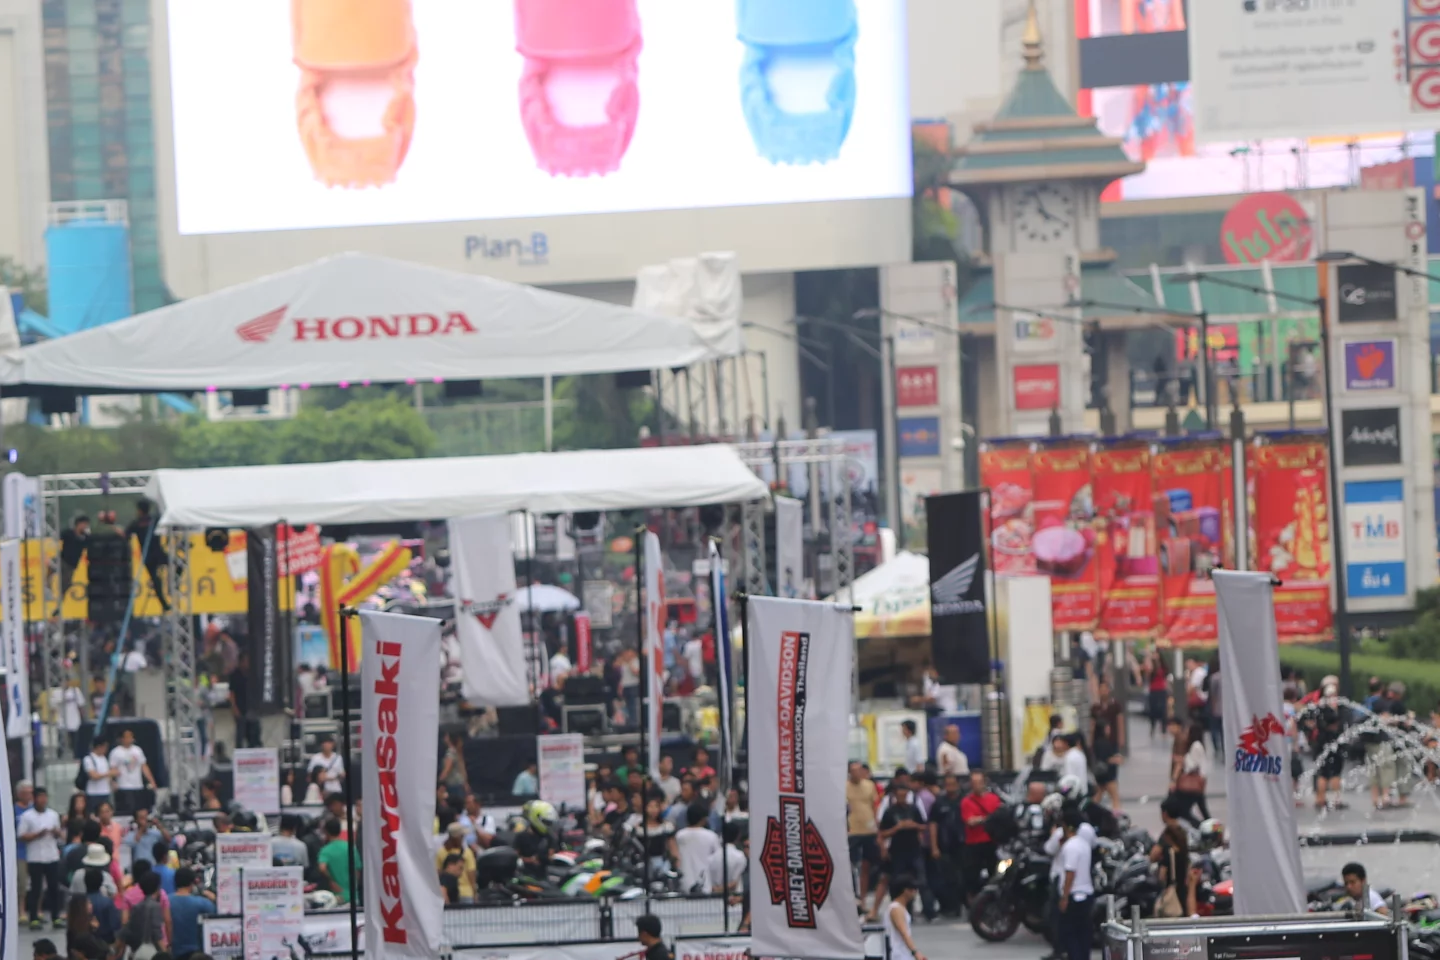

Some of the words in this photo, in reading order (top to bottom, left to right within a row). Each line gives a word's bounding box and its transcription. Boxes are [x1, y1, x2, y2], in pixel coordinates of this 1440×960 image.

[293, 310, 480, 342] HONDA
[1351, 514, 1400, 540] TMB
[931, 600, 984, 616] HONDA
[797, 636, 809, 694] Thailand
[780, 634, 796, 790] HARLEY-DAVIDSON
[374, 640, 407, 944] Kawasaki
[784, 803, 810, 921] HARLEY-DAVIDSON
